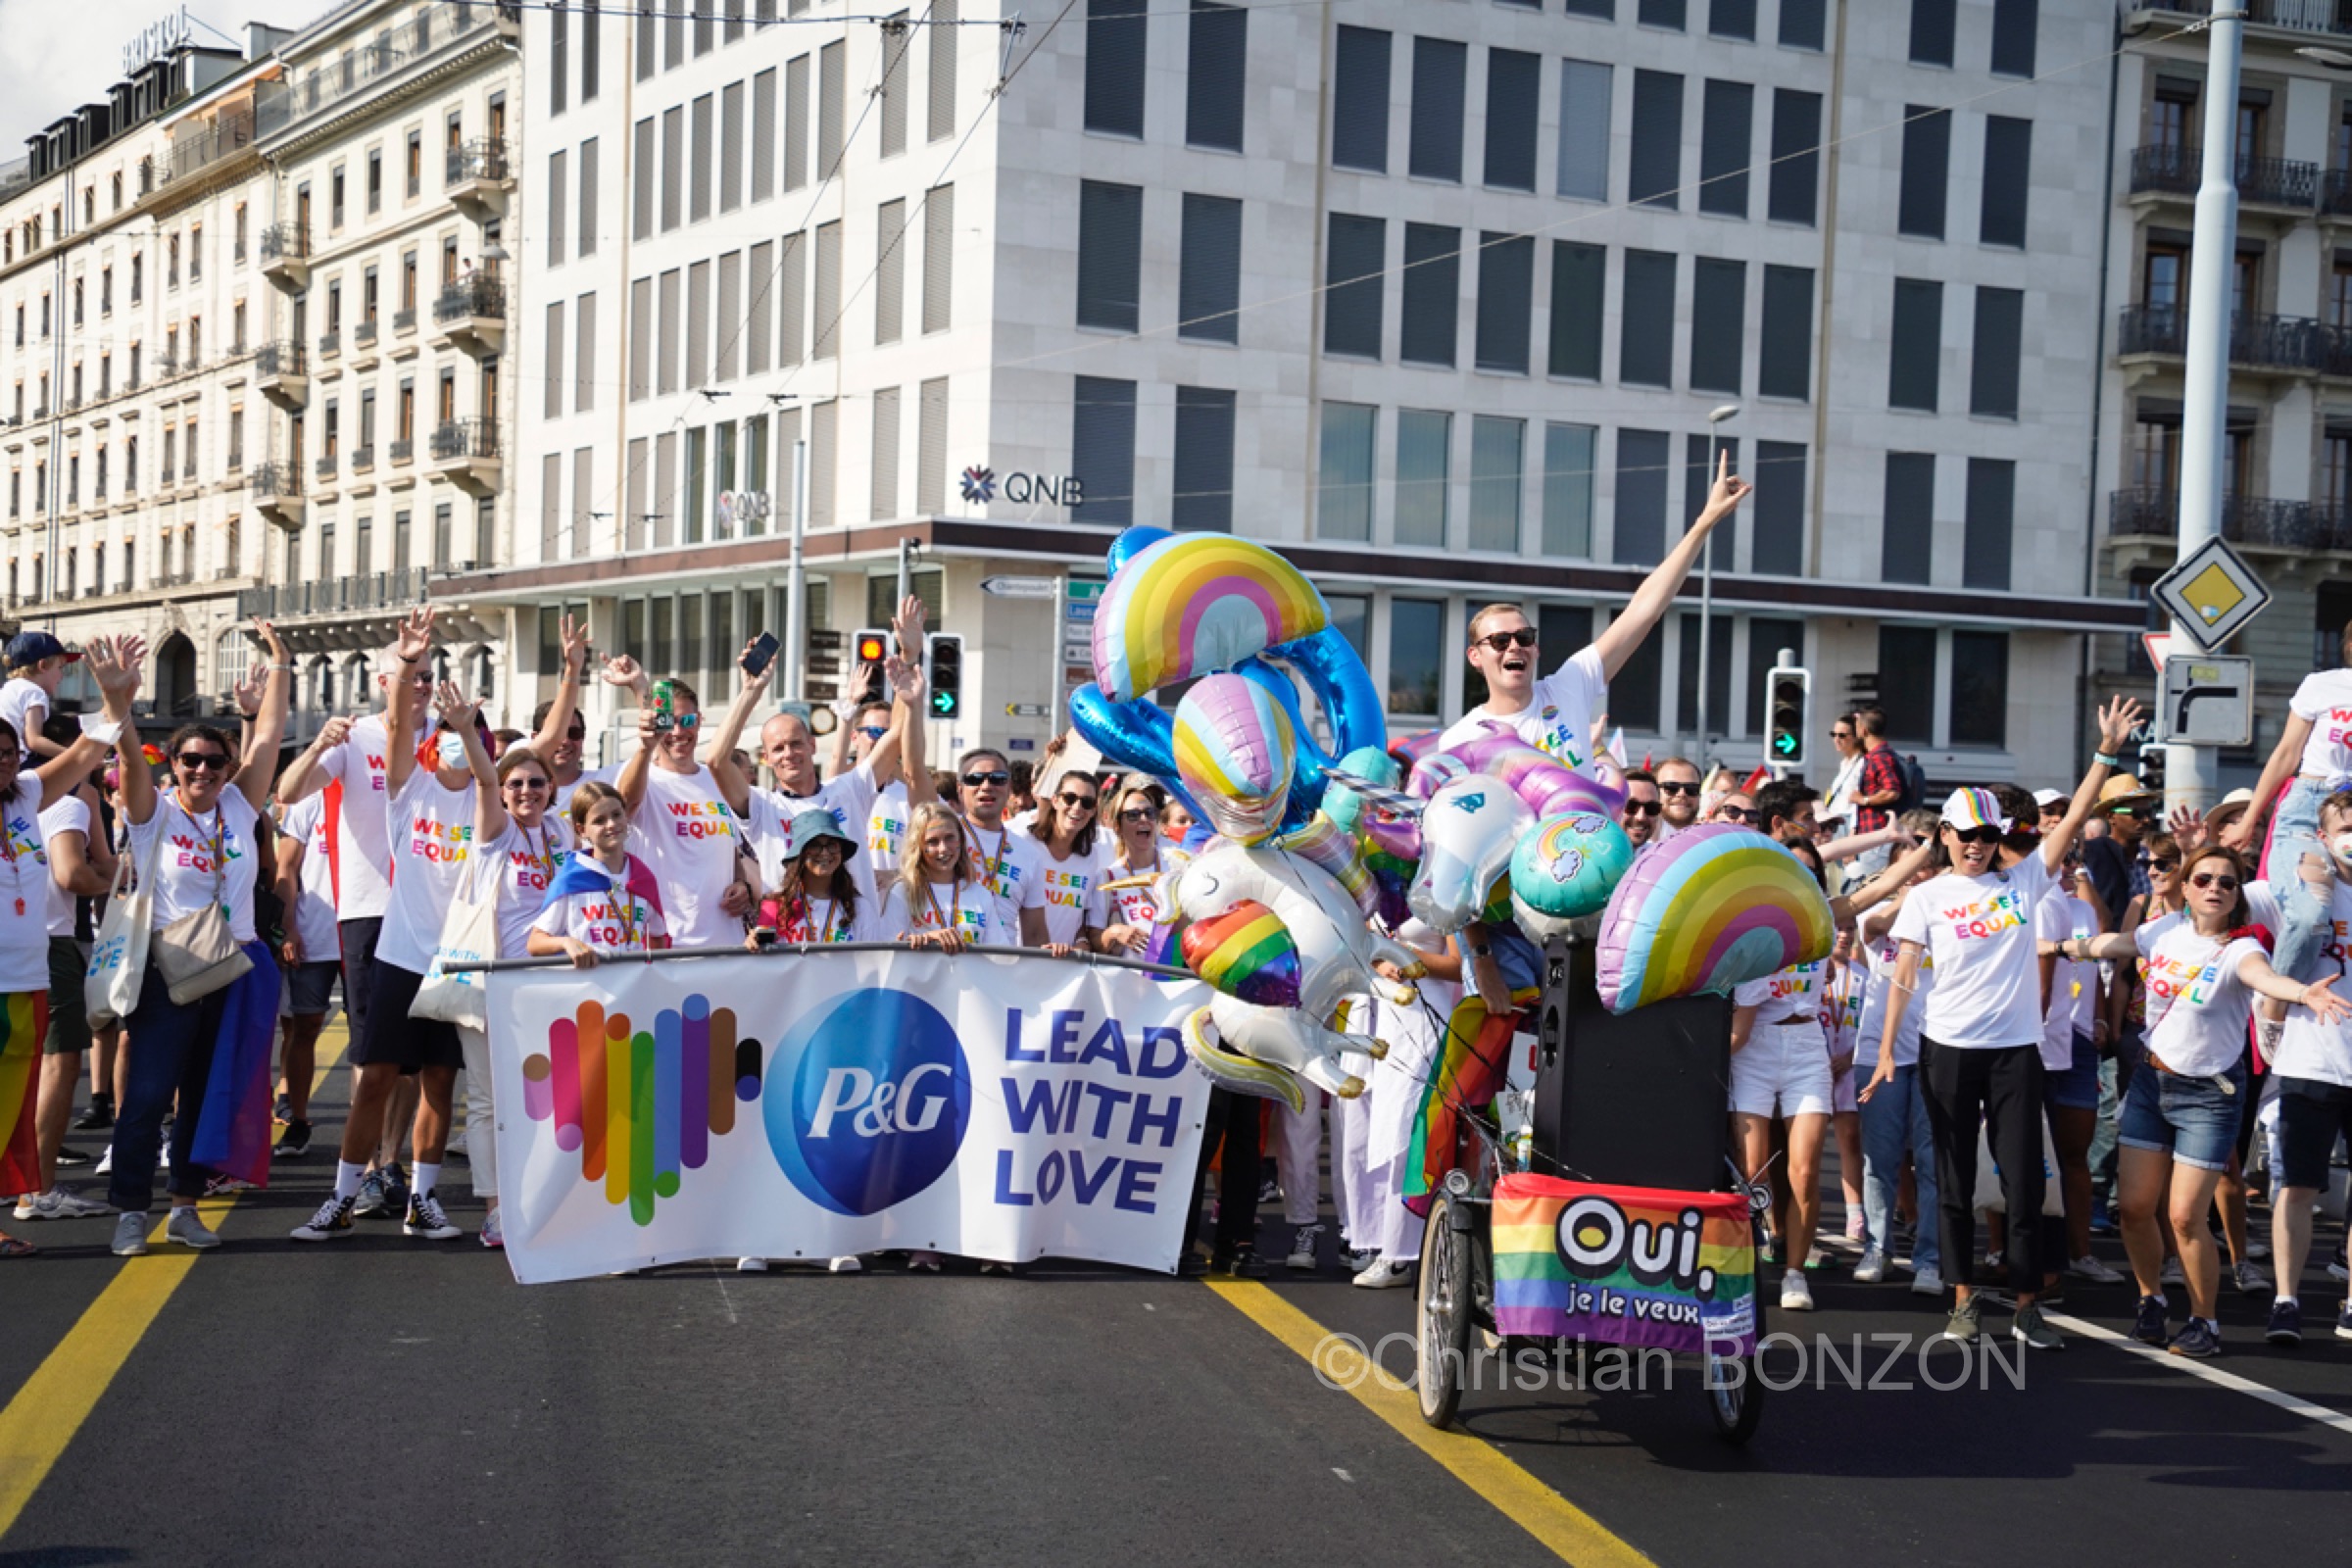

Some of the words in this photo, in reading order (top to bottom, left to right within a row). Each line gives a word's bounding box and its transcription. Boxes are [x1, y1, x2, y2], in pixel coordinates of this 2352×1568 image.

[1004, 471, 1085, 508] QNB
[667, 803, 703, 816] WE
[414, 817, 444, 837] WE
[449, 825, 474, 841] SE
[412, 838, 467, 863] EQUA
[1943, 903, 1984, 919] WE
[1987, 889, 2021, 912] SEE
[1954, 910, 2028, 940] EQUAL
[1004, 1006, 1189, 1080] LEAD
[807, 1062, 954, 1140] P&G
[1000, 1077, 1183, 1148] WITH
[994, 1149, 1164, 1214] LOVE
[1565, 1282, 1593, 1315] je
[1600, 1288, 1626, 1315] le
[1633, 1298, 1699, 1324] veux
